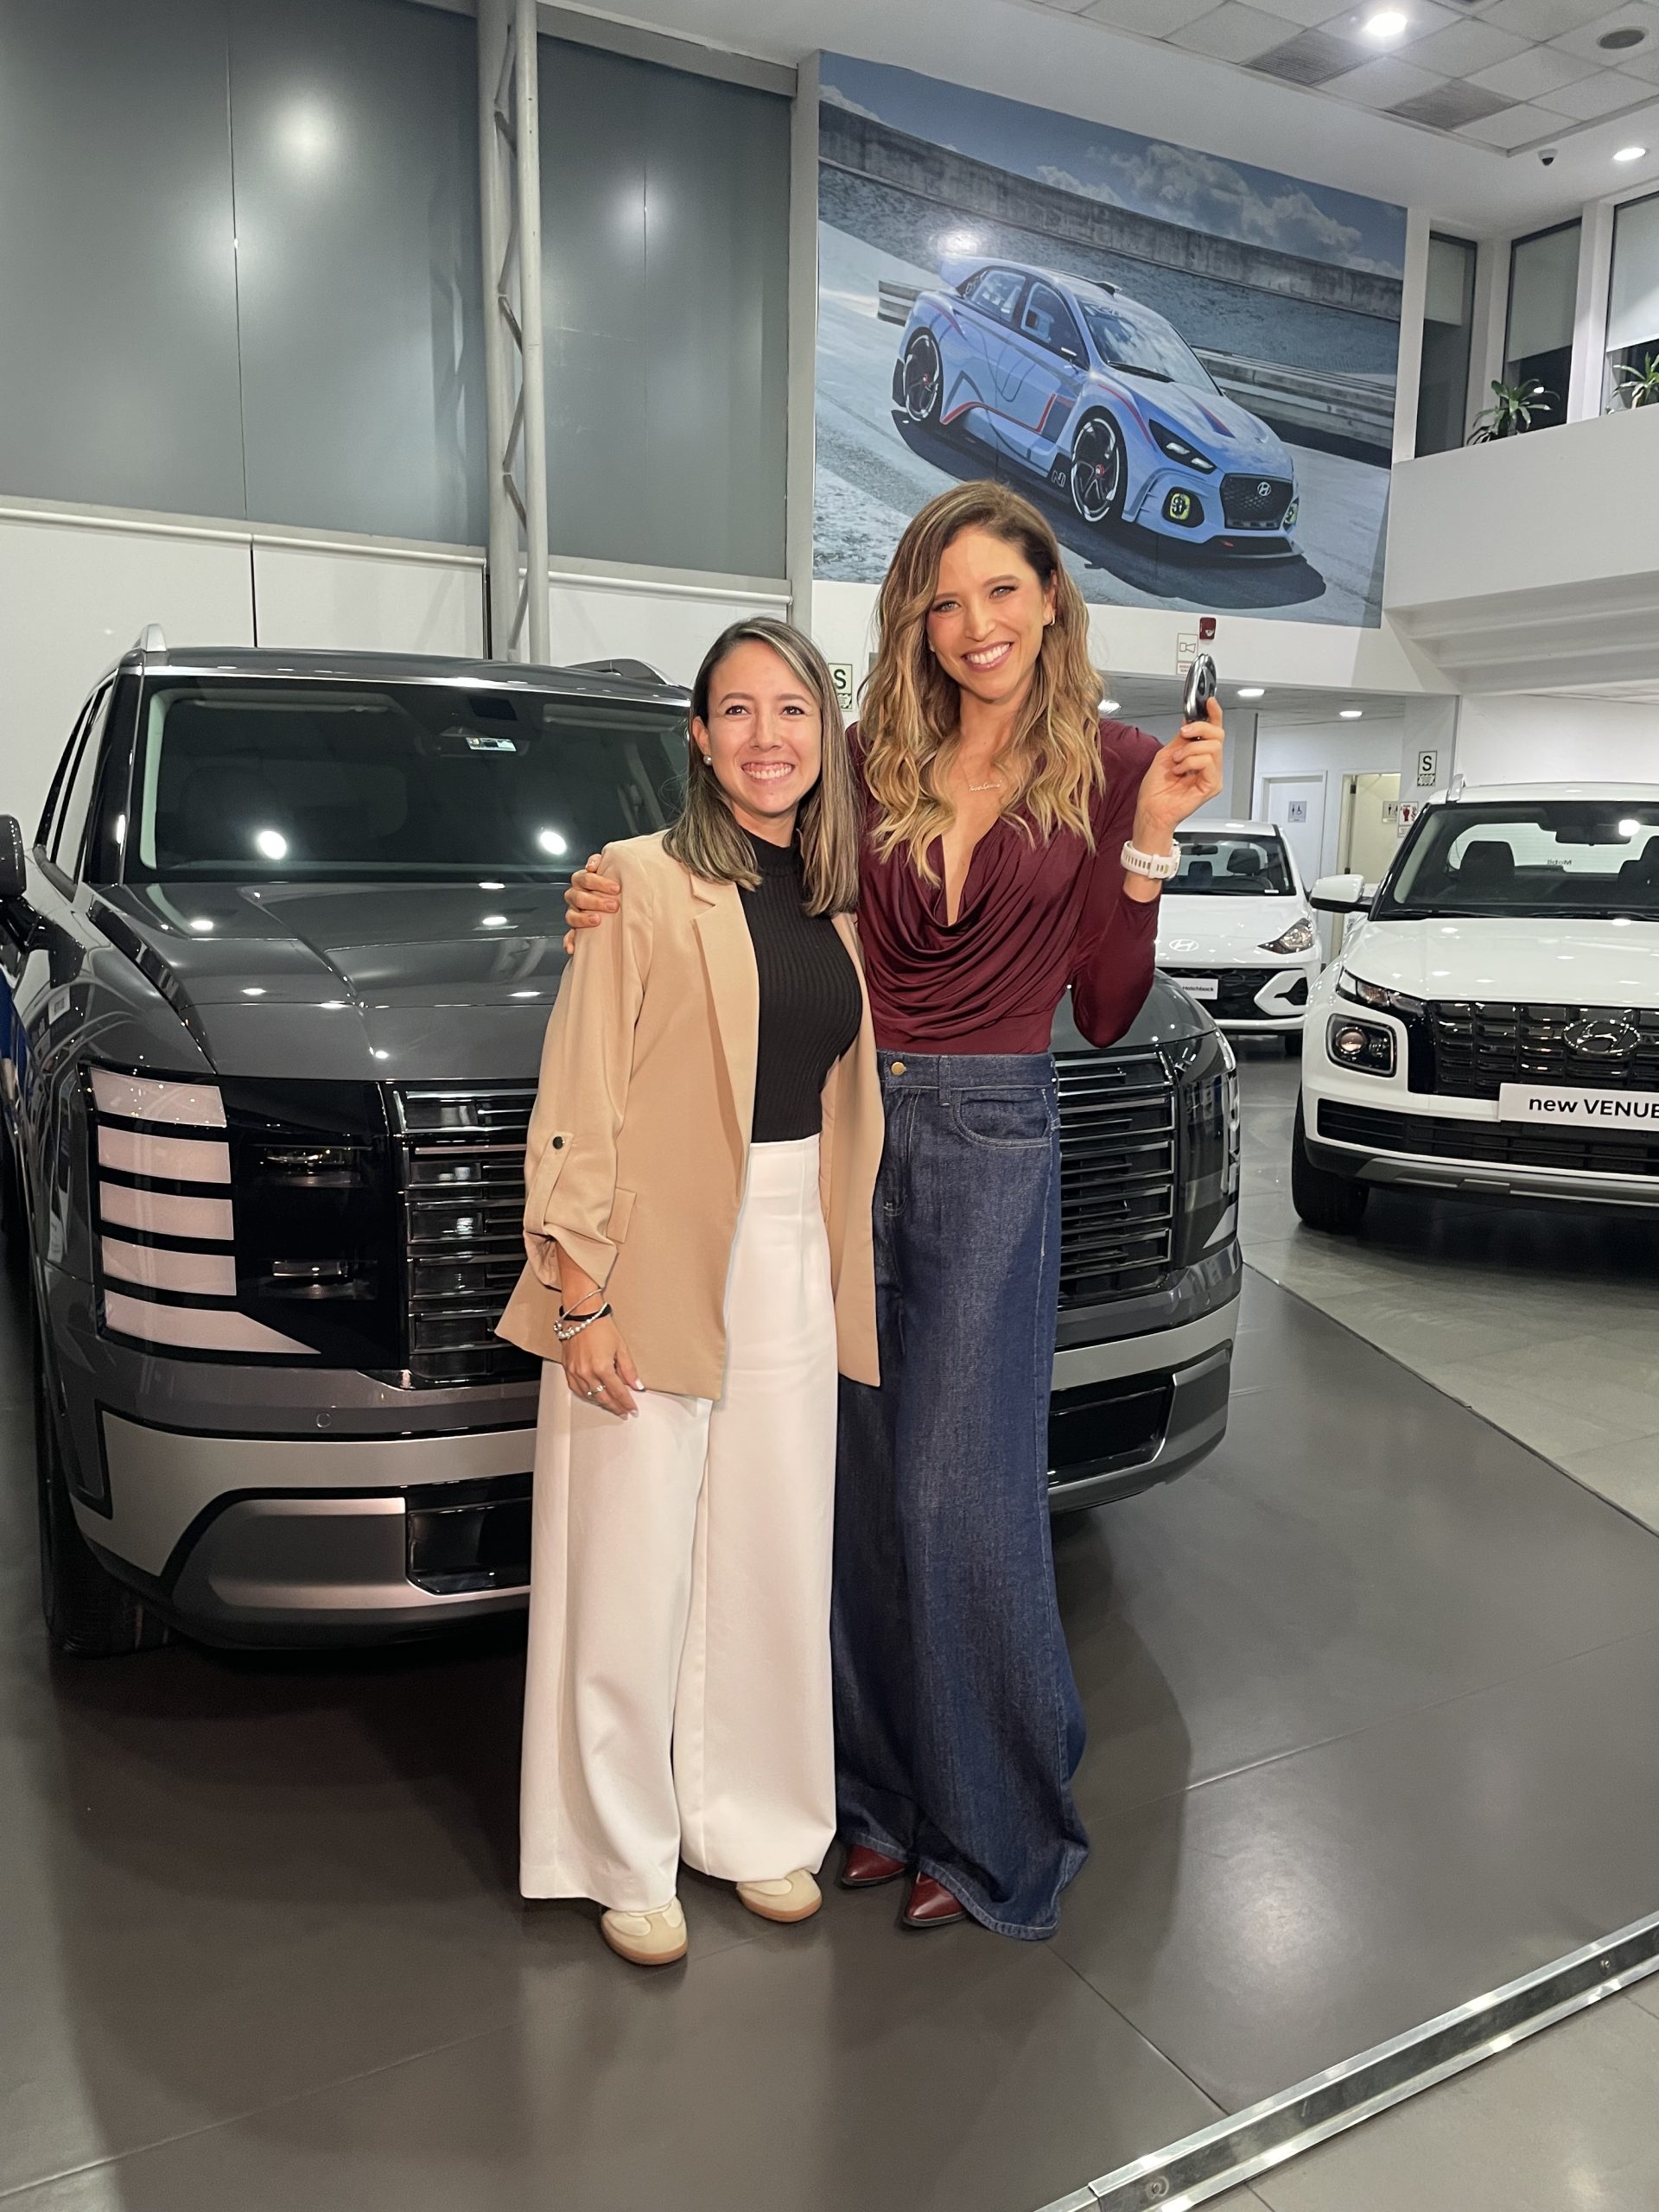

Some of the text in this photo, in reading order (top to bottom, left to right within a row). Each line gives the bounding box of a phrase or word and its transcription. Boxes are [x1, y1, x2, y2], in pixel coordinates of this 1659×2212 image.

[834, 669, 847, 690] S
[1422, 755, 1432, 772] S
[1529, 1098, 1659, 1119] new VENUE
